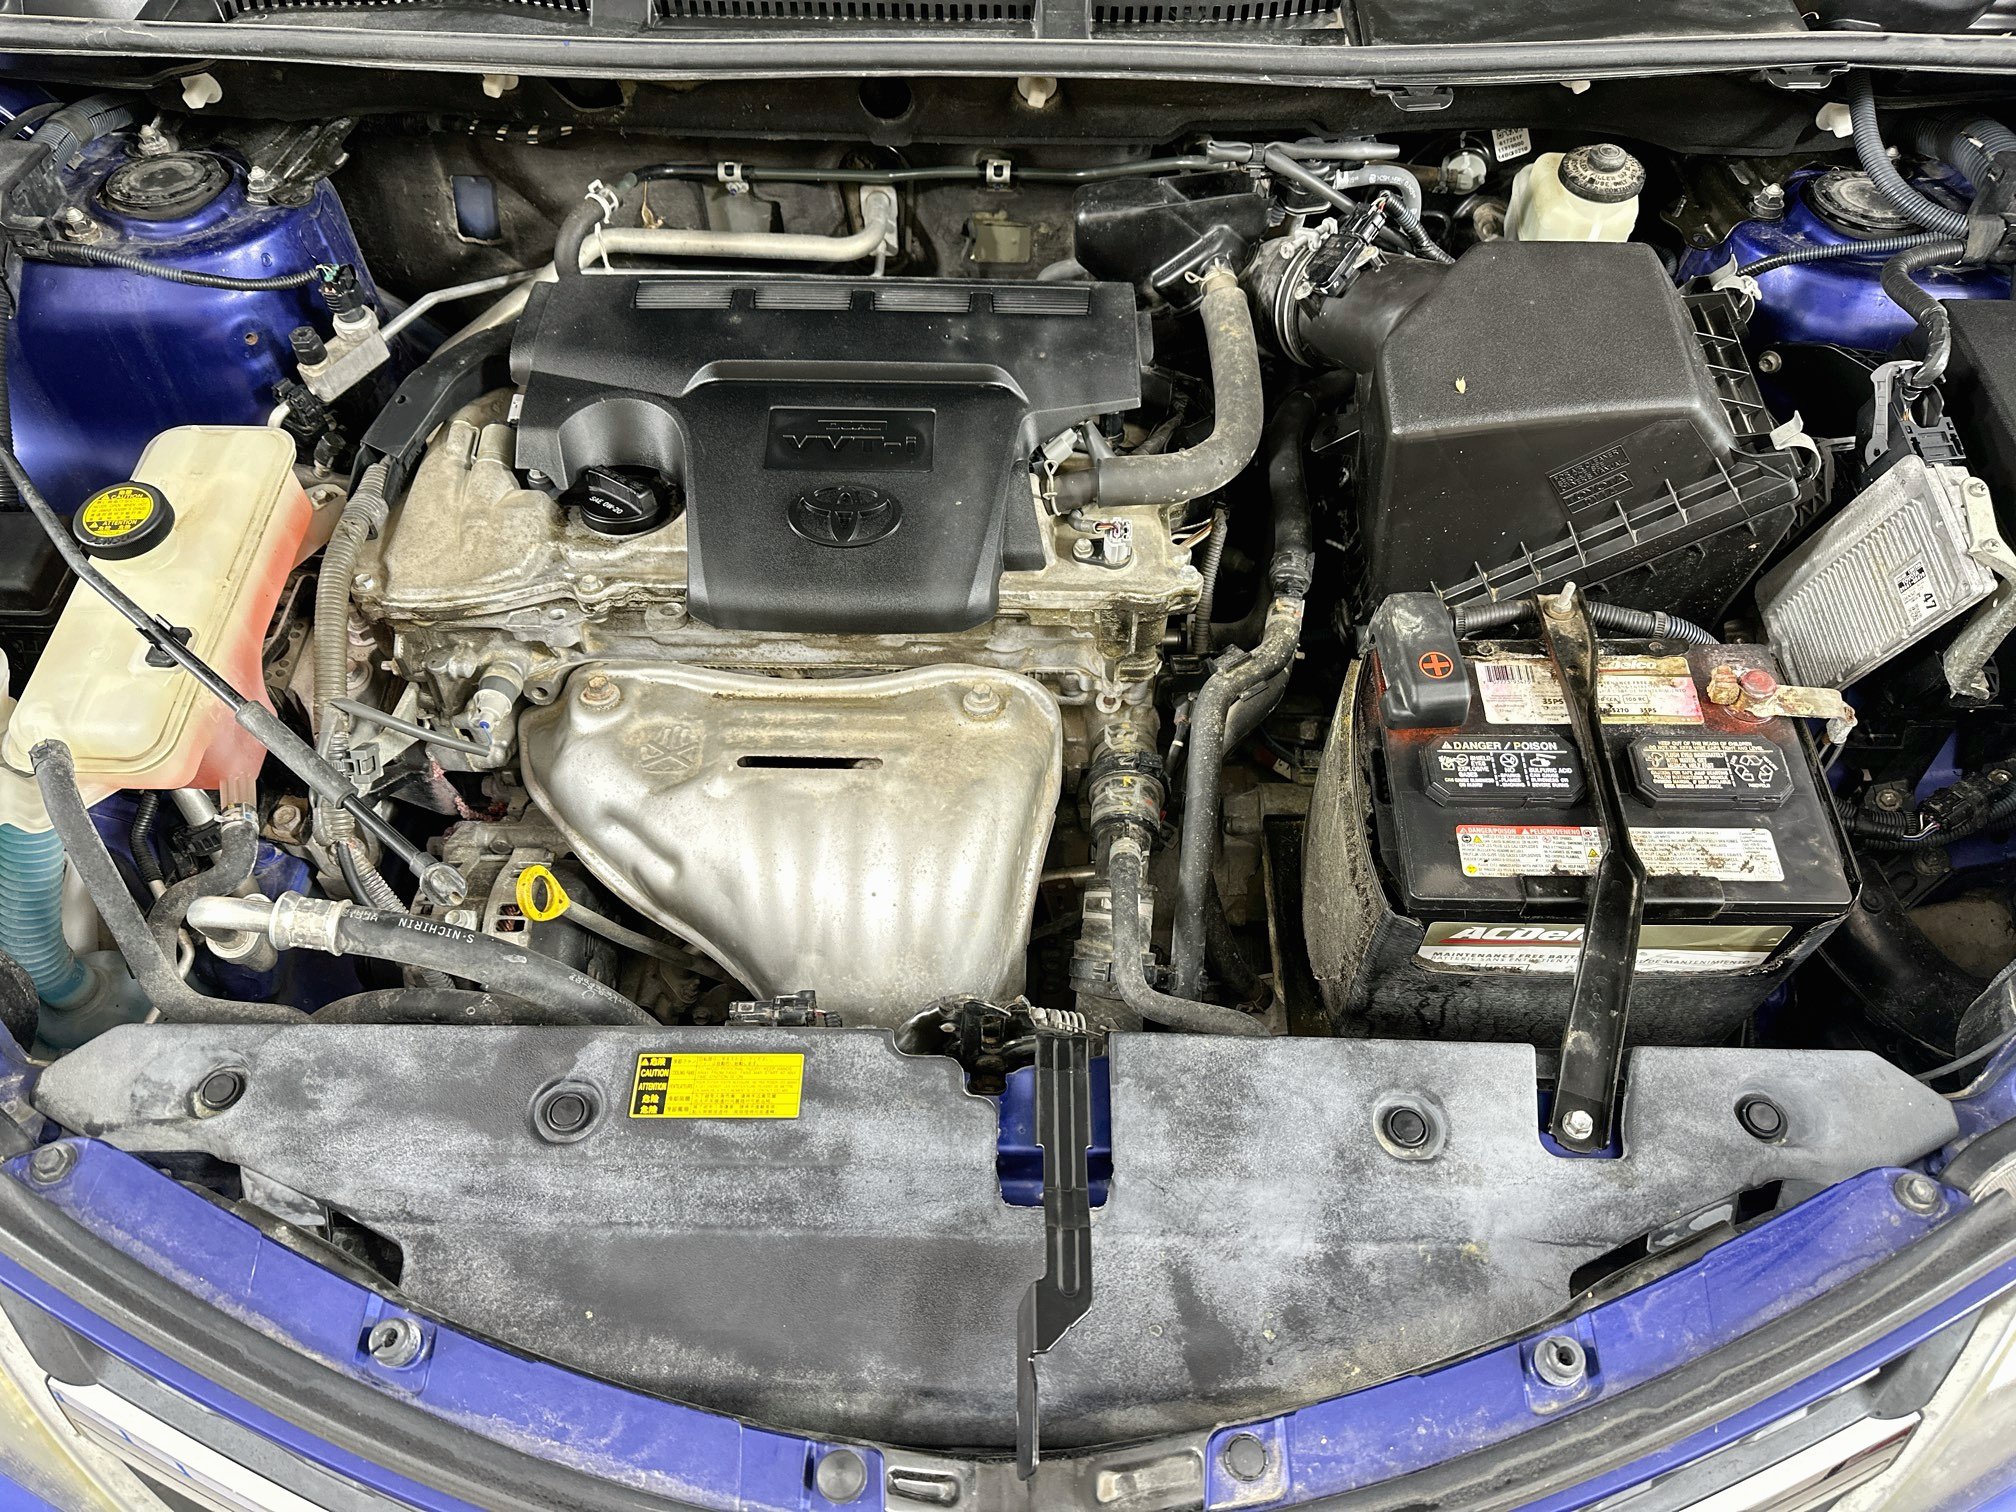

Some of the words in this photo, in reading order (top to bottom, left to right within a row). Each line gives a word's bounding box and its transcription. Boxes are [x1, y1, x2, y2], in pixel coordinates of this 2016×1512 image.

[588, 495, 604, 505] SAE
[602, 501, 624, 515] 0W-20
[1923, 592, 1937, 610] 47
[1453, 741, 1502, 750] DANGER
[1503, 741, 1511, 750] /
[1513, 741, 1558, 750] POISON
[1449, 926, 1584, 941] ACDel
[640, 1068, 670, 1078] CAUTION
[638, 1082, 667, 1091] ATTENTION
